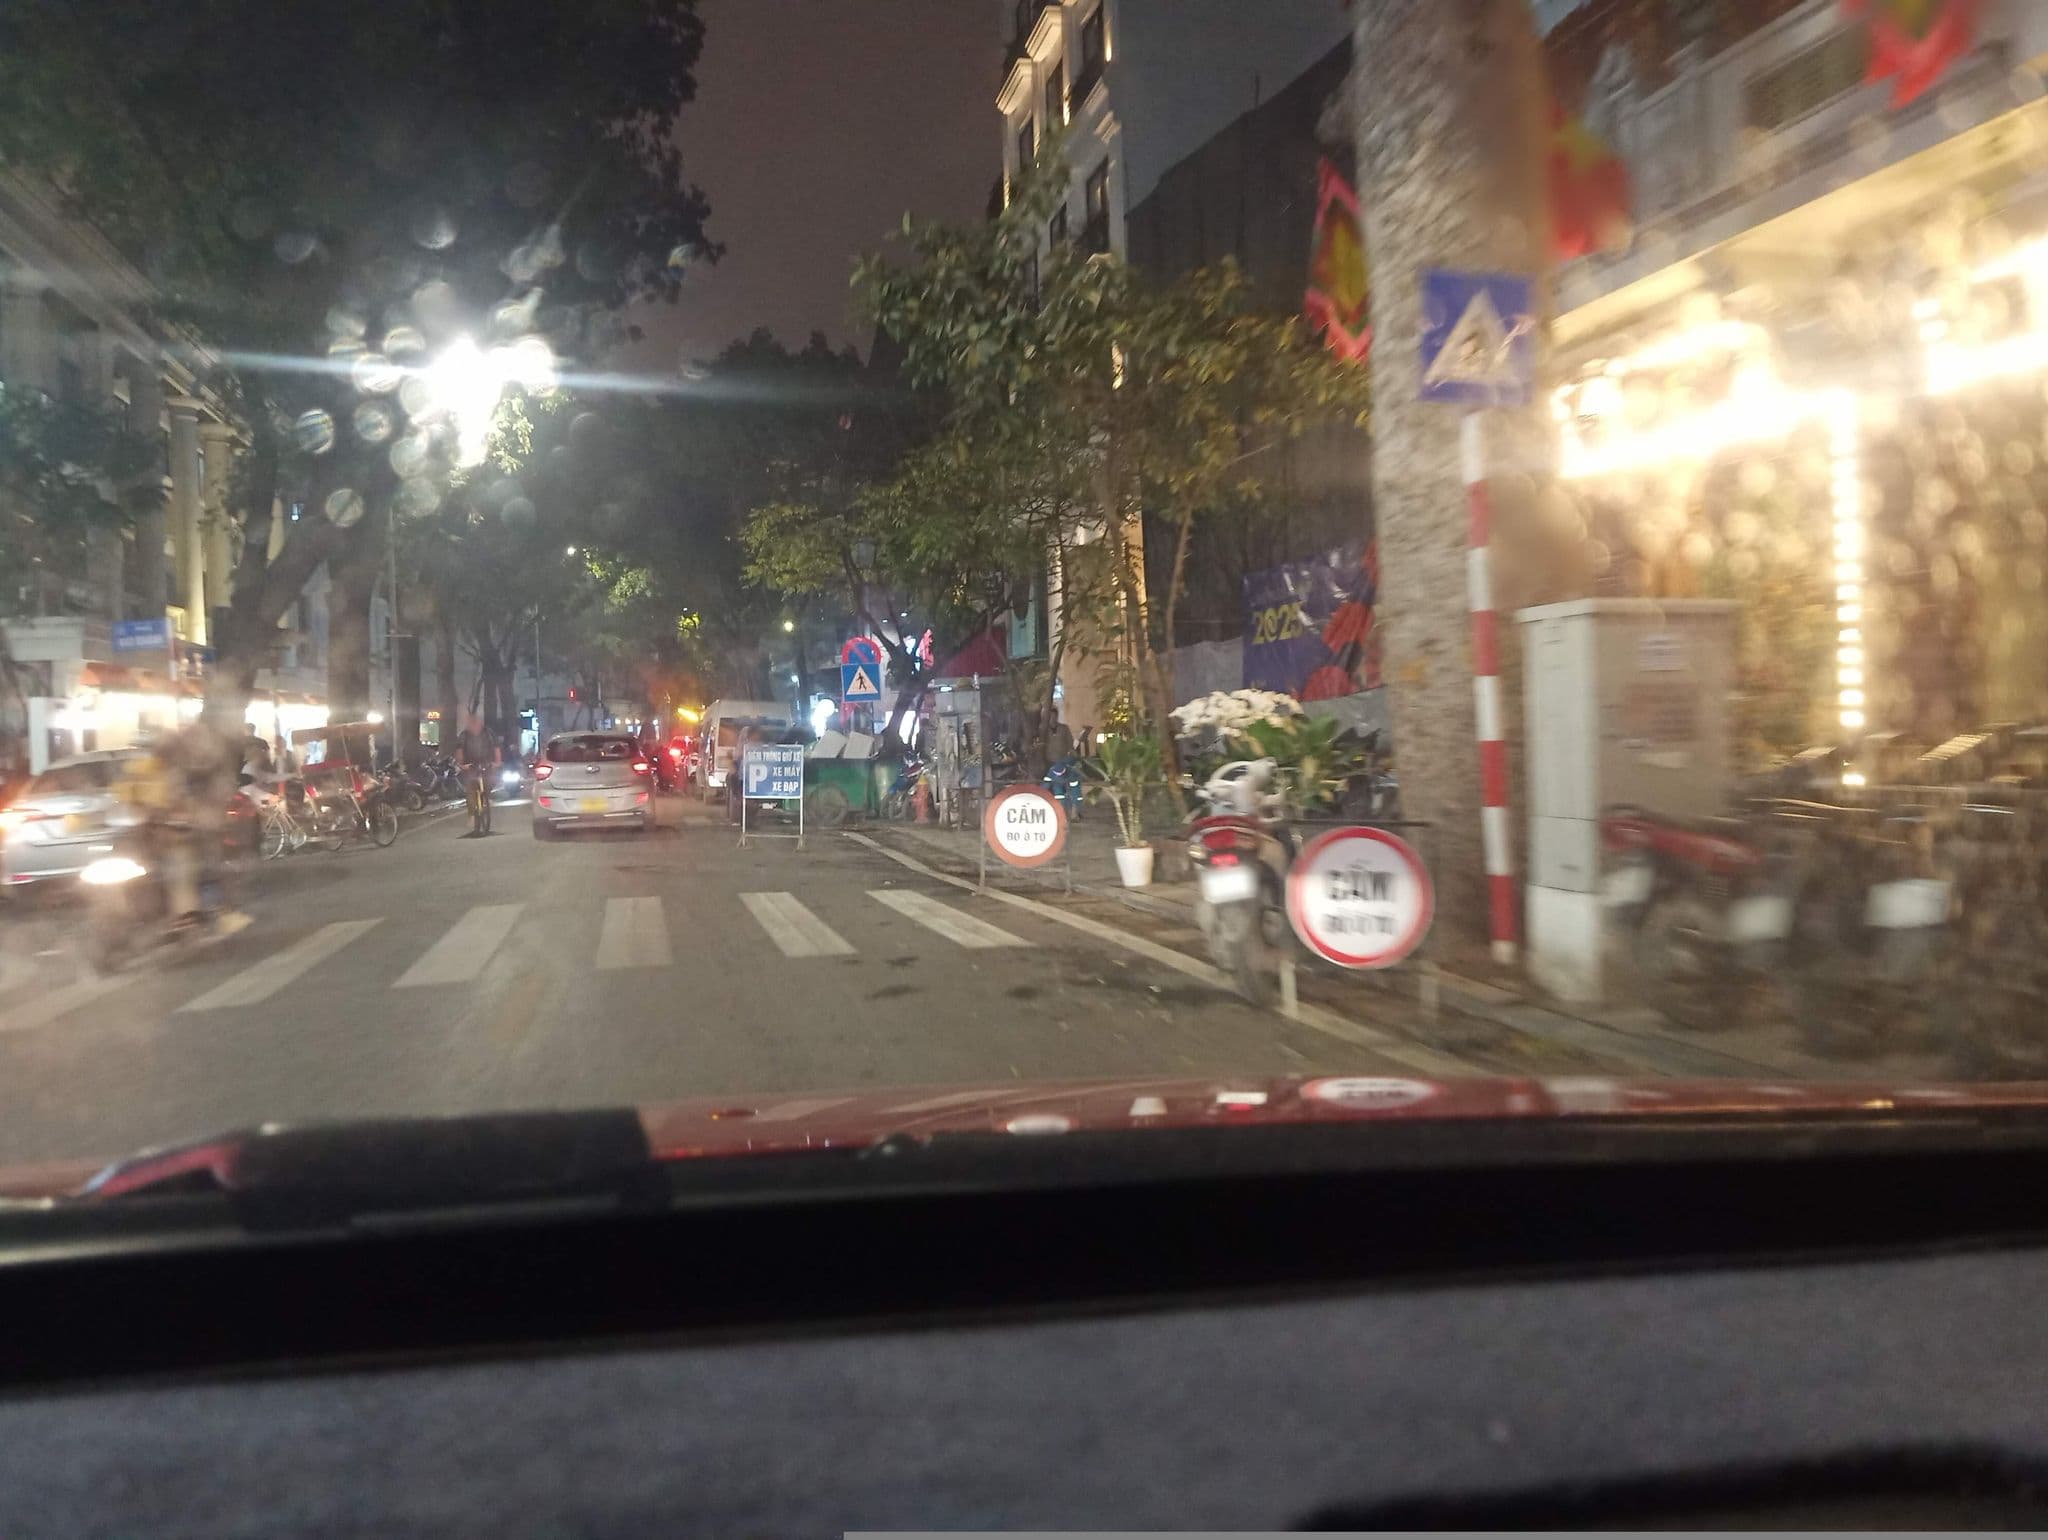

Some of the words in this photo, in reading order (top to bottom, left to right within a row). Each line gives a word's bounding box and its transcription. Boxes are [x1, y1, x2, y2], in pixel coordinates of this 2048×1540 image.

[749, 763, 768, 793] P
[772, 766, 783, 777] XE
[784, 764, 801, 777] MÁY
[772, 781, 783, 792] XE
[1007, 802, 1046, 824] CẤM
